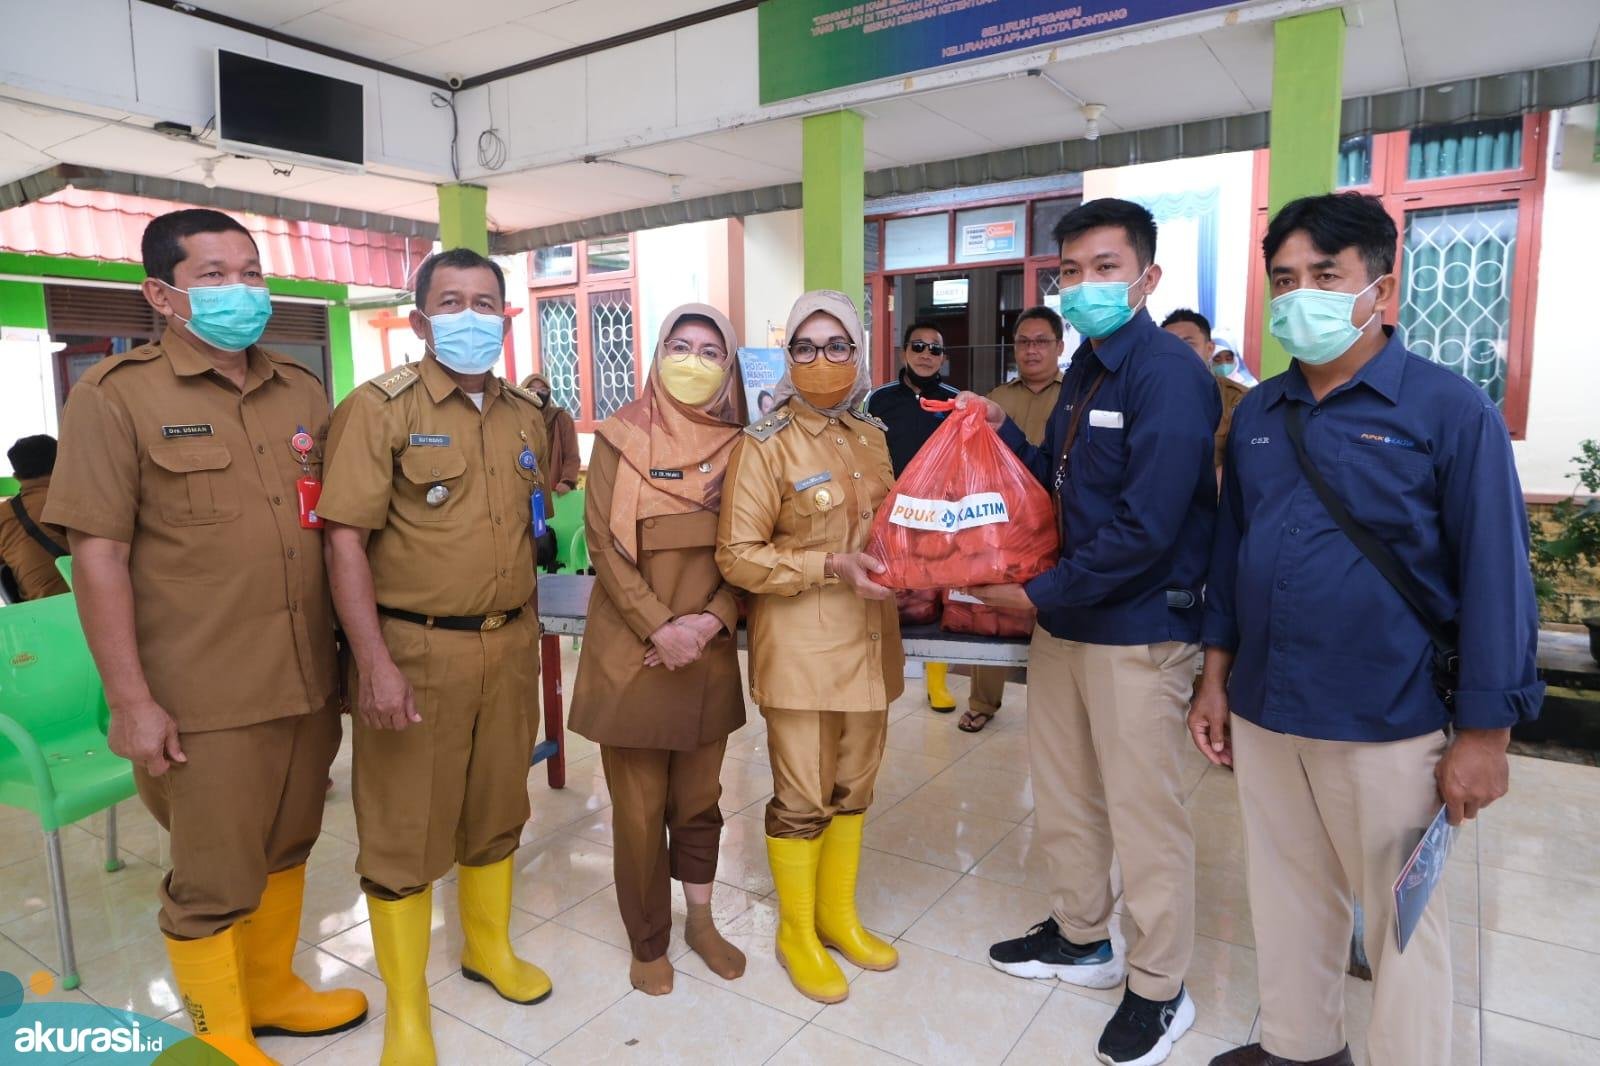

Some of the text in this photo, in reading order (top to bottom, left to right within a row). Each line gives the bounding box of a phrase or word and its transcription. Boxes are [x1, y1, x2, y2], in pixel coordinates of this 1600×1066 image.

[942, 8, 1128, 58] KELURAHAN API-API KOTA BONTANG
[981, 6, 1082, 38] SELURUH PEGAWAI
